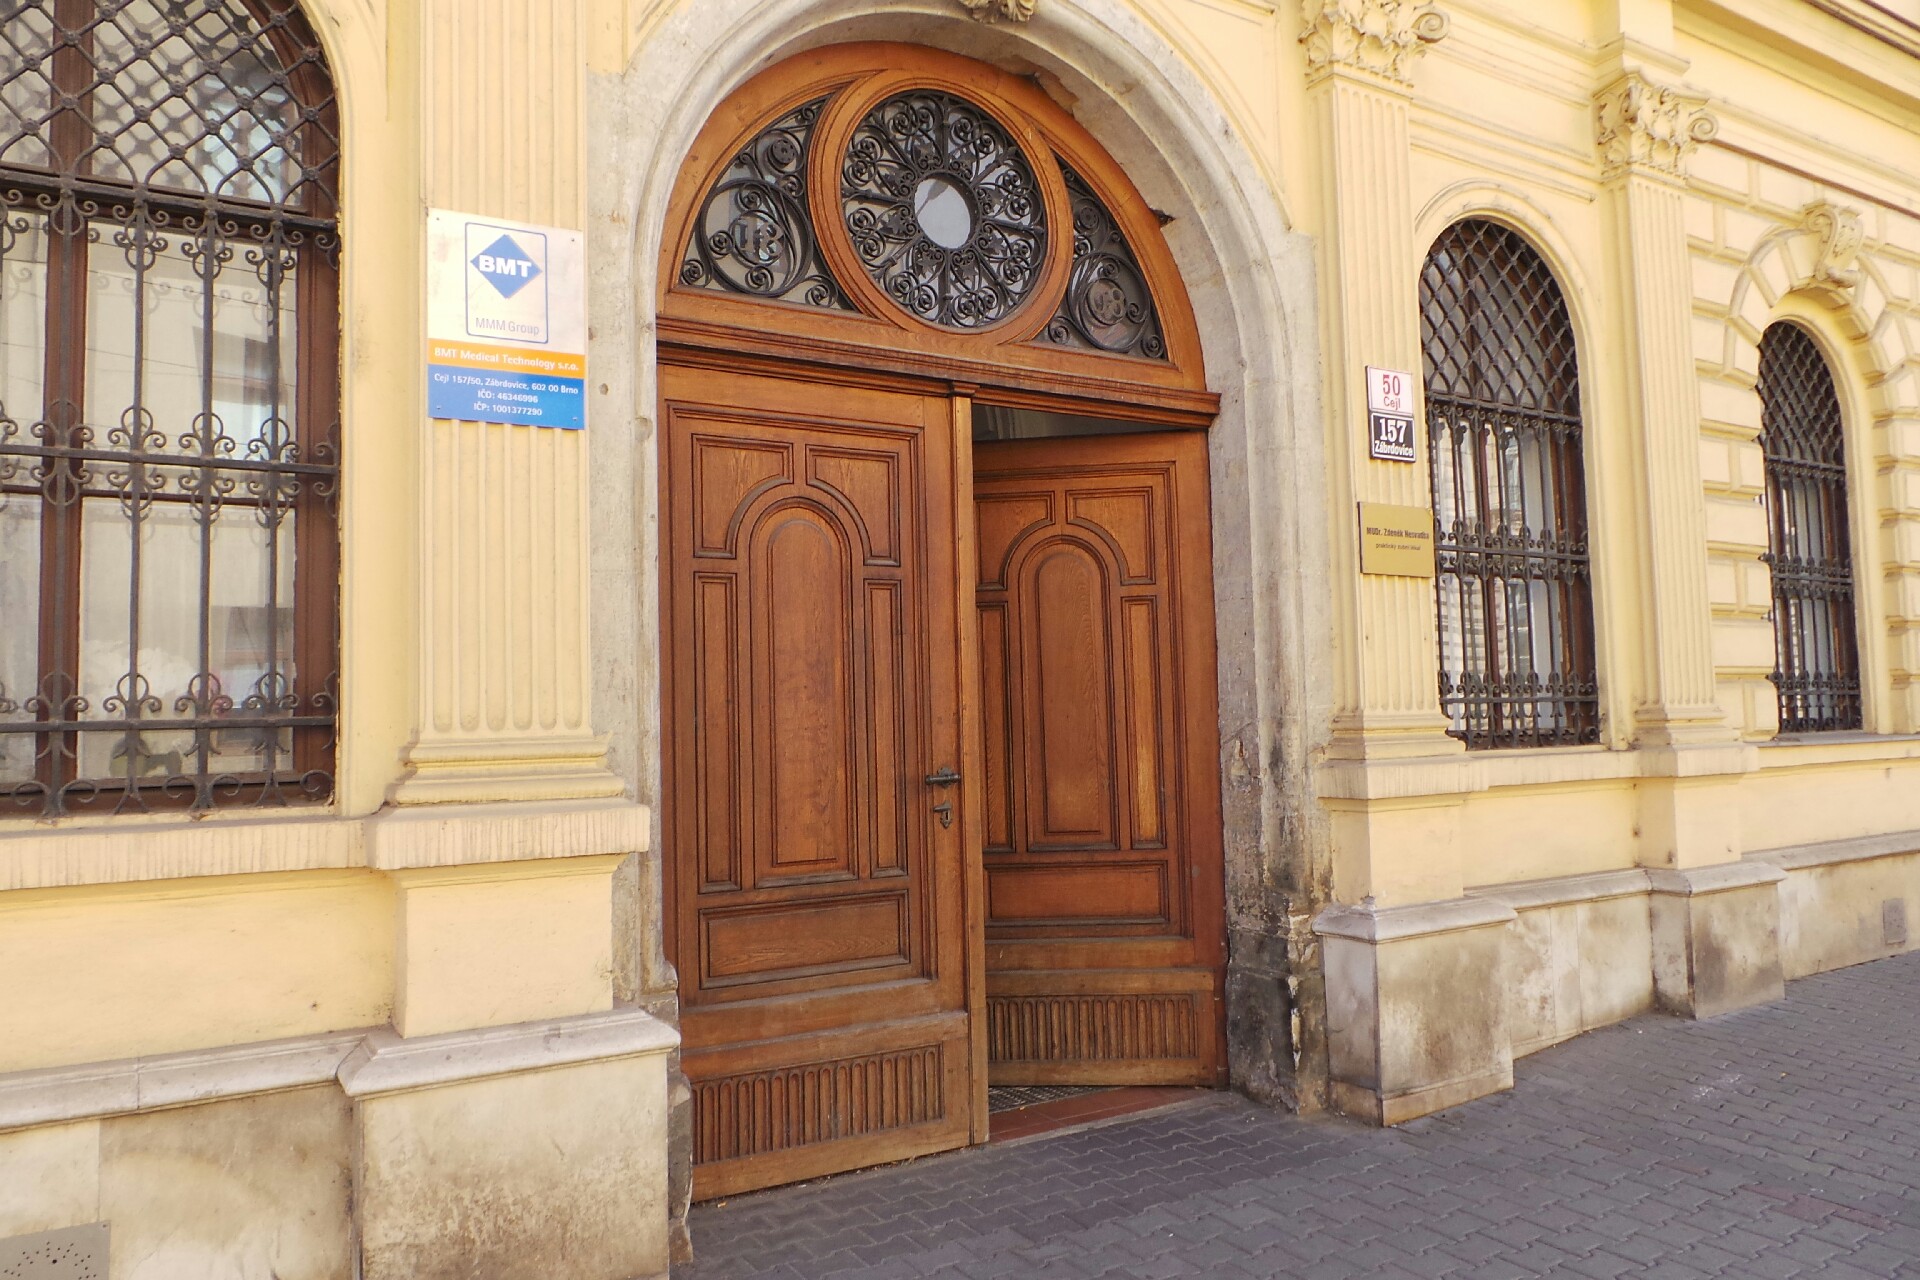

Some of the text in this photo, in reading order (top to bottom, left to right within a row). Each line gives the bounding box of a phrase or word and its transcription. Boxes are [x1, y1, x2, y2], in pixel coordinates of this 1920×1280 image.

[479, 254, 532, 278] BMT
[475, 317, 540, 336] MMM Group
[434, 347, 579, 371] BMT Medical Technology s.r.o.
[434, 373, 450, 384] Cejl
[531, 382, 546, 392] 602
[548, 384, 559, 393] 00
[560, 385, 579, 395] Brno
[1383, 374, 1401, 396] 50
[497, 391, 539, 403] 46346996
[1383, 396, 1401, 411] Cejl
[492, 404, 543, 416] 1001377290
[1379, 418, 1407, 443] 157
[1374, 440, 1414, 457] Zábrdovice
[1366, 526, 1383, 536] MUDr.
